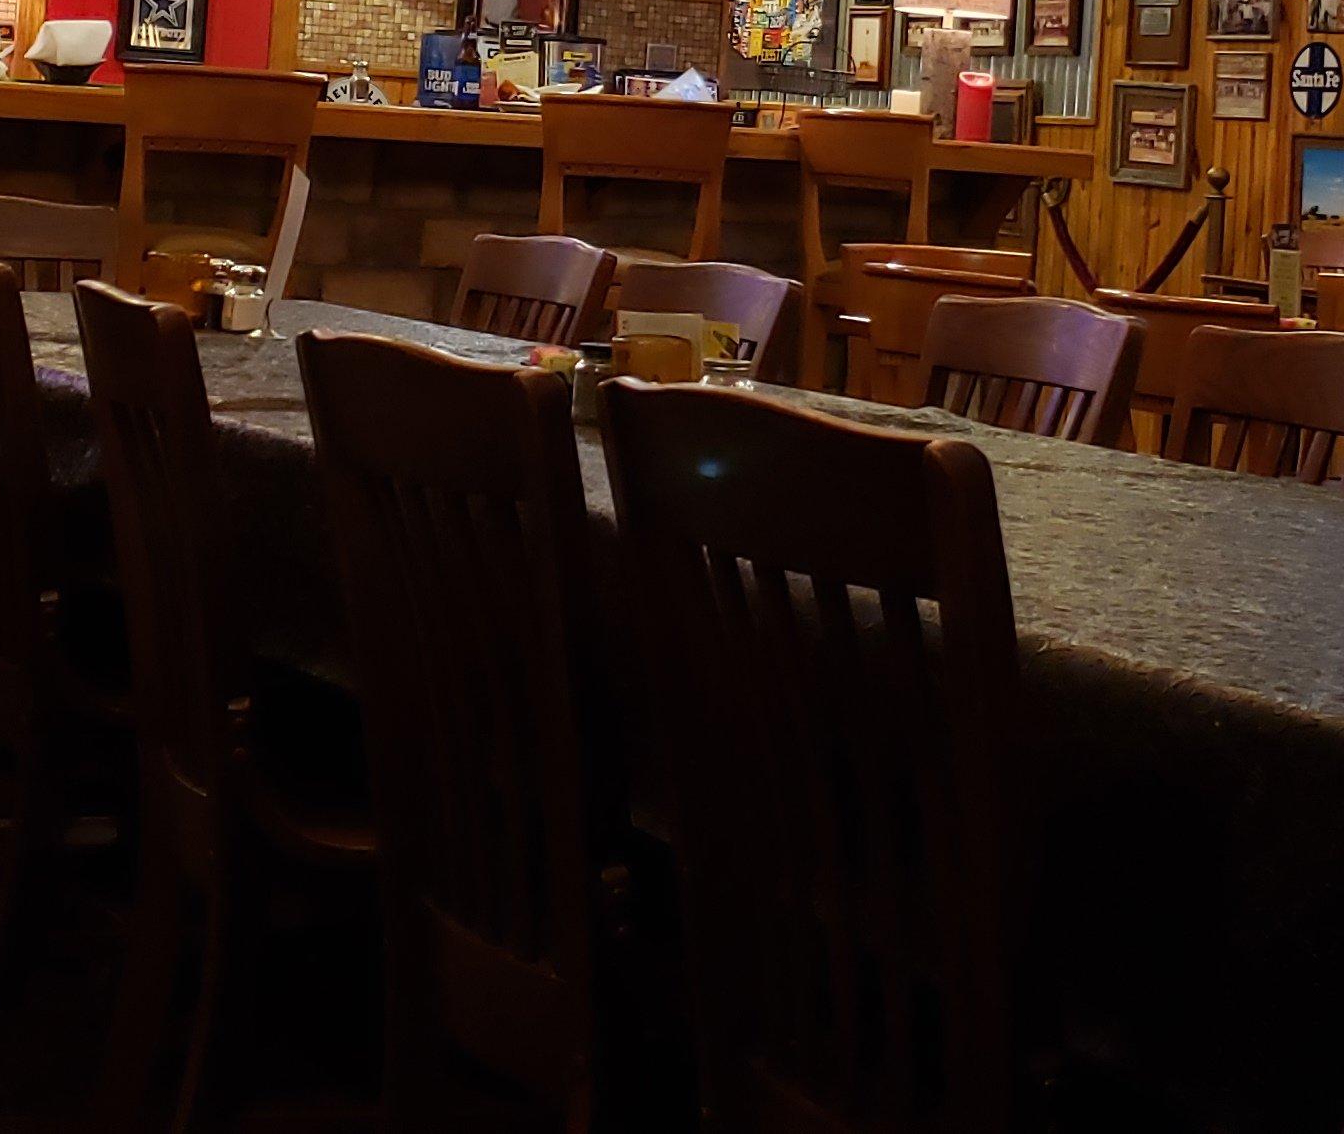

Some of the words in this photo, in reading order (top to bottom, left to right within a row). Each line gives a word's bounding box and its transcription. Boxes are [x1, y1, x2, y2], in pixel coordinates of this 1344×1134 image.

[426, 69, 453, 82] BUD
[1291, 69, 1325, 88] Santa
[1325, 70, 1341, 88] Fe
[423, 79, 459, 97] LIGHT
